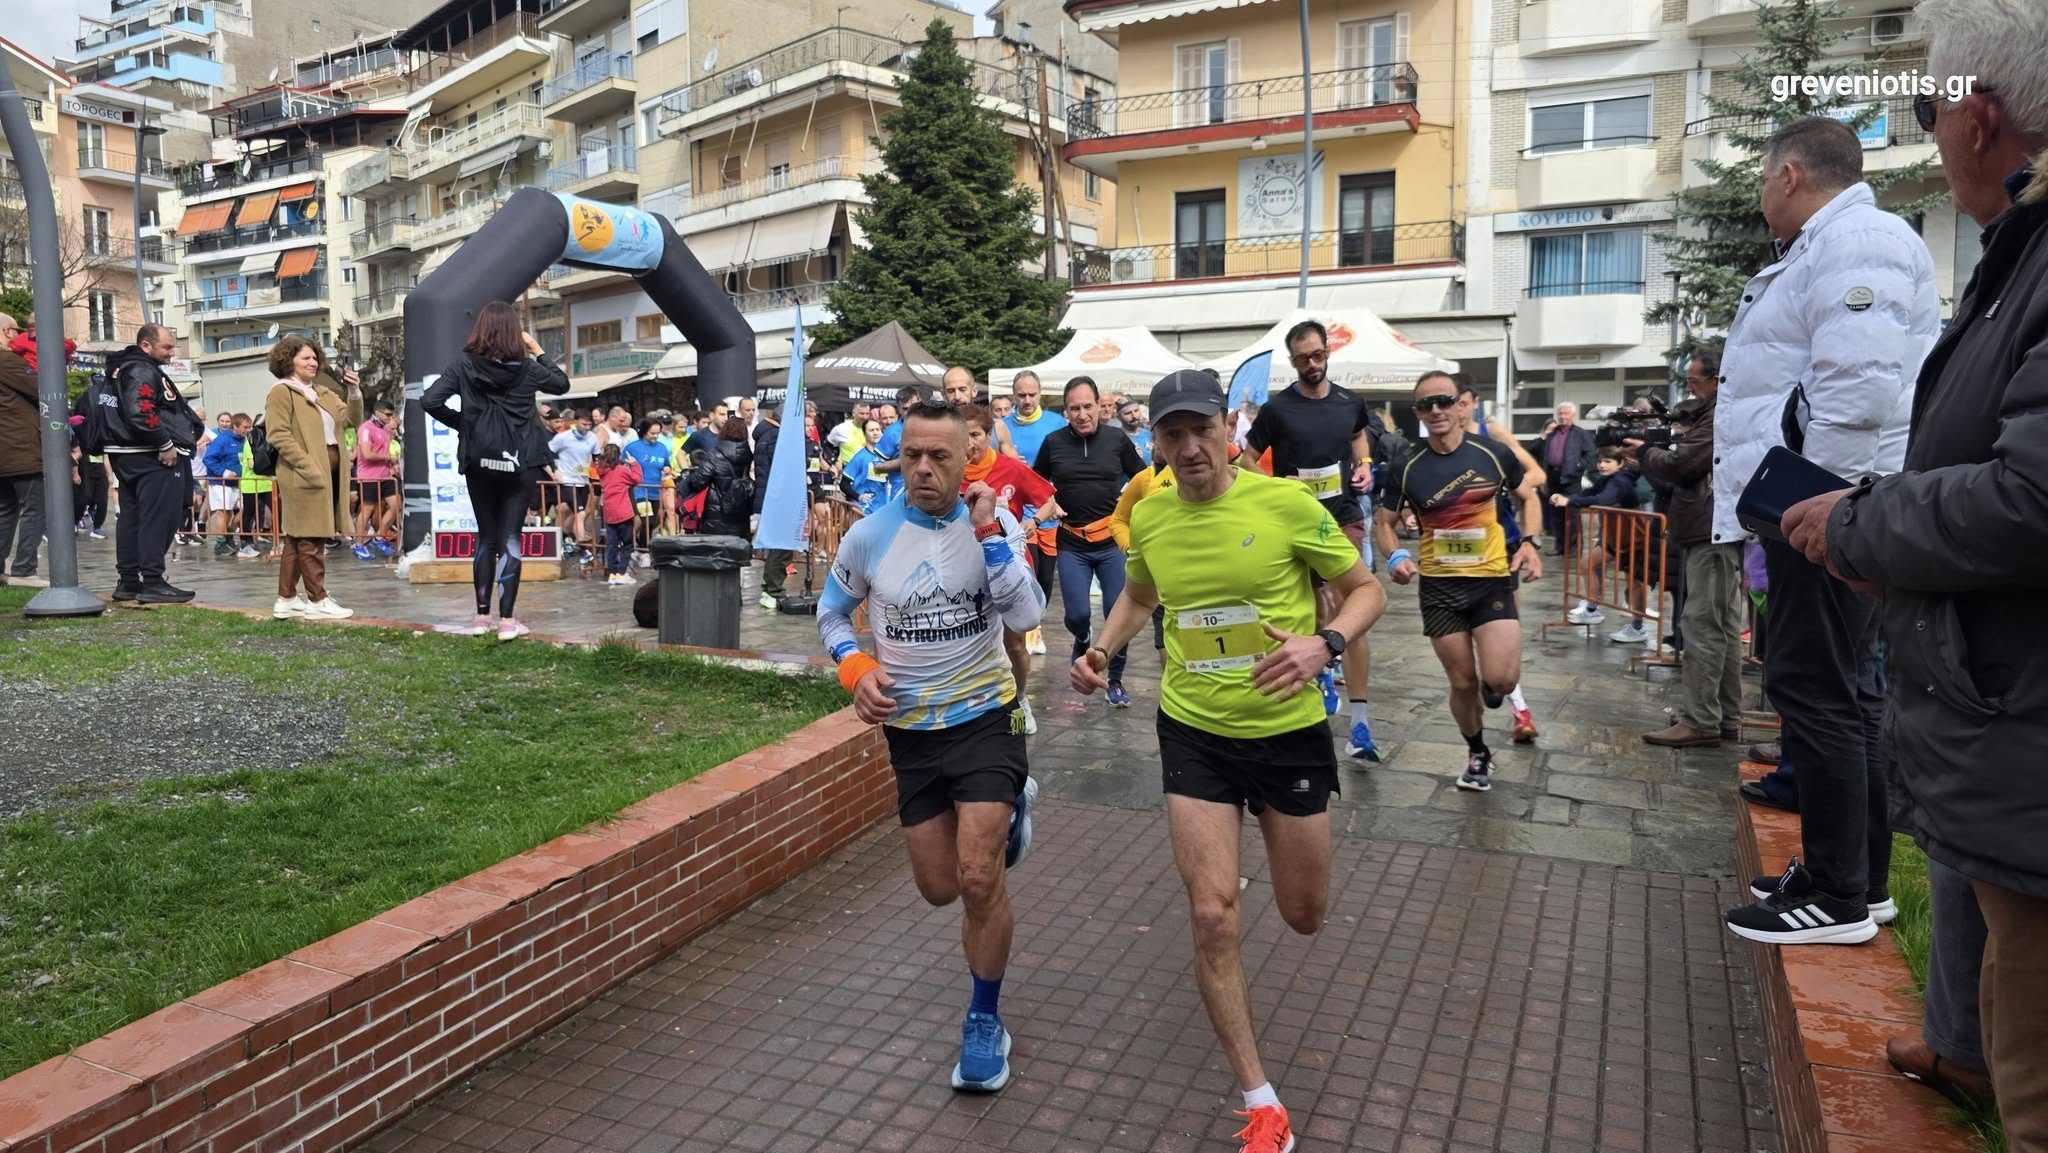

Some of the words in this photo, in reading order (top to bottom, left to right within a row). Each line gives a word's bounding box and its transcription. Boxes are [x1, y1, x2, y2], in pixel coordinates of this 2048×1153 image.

[1262, 188, 1294, 197] Anna's
[1262, 196, 1294, 204] Salon
[1517, 208, 1595, 228] ΚΟΥΡΕΙΟ
[815, 357, 838, 368] MY
[834, 356, 903, 372] ADVENTURE
[480, 458, 515, 472] PUMA
[1313, 481, 1327, 492] 17
[1447, 543, 1472, 553] 115
[1203, 615, 1218, 626] 10
[885, 615, 988, 643] SKYRUNNING
[1215, 636, 1225, 655] 1
